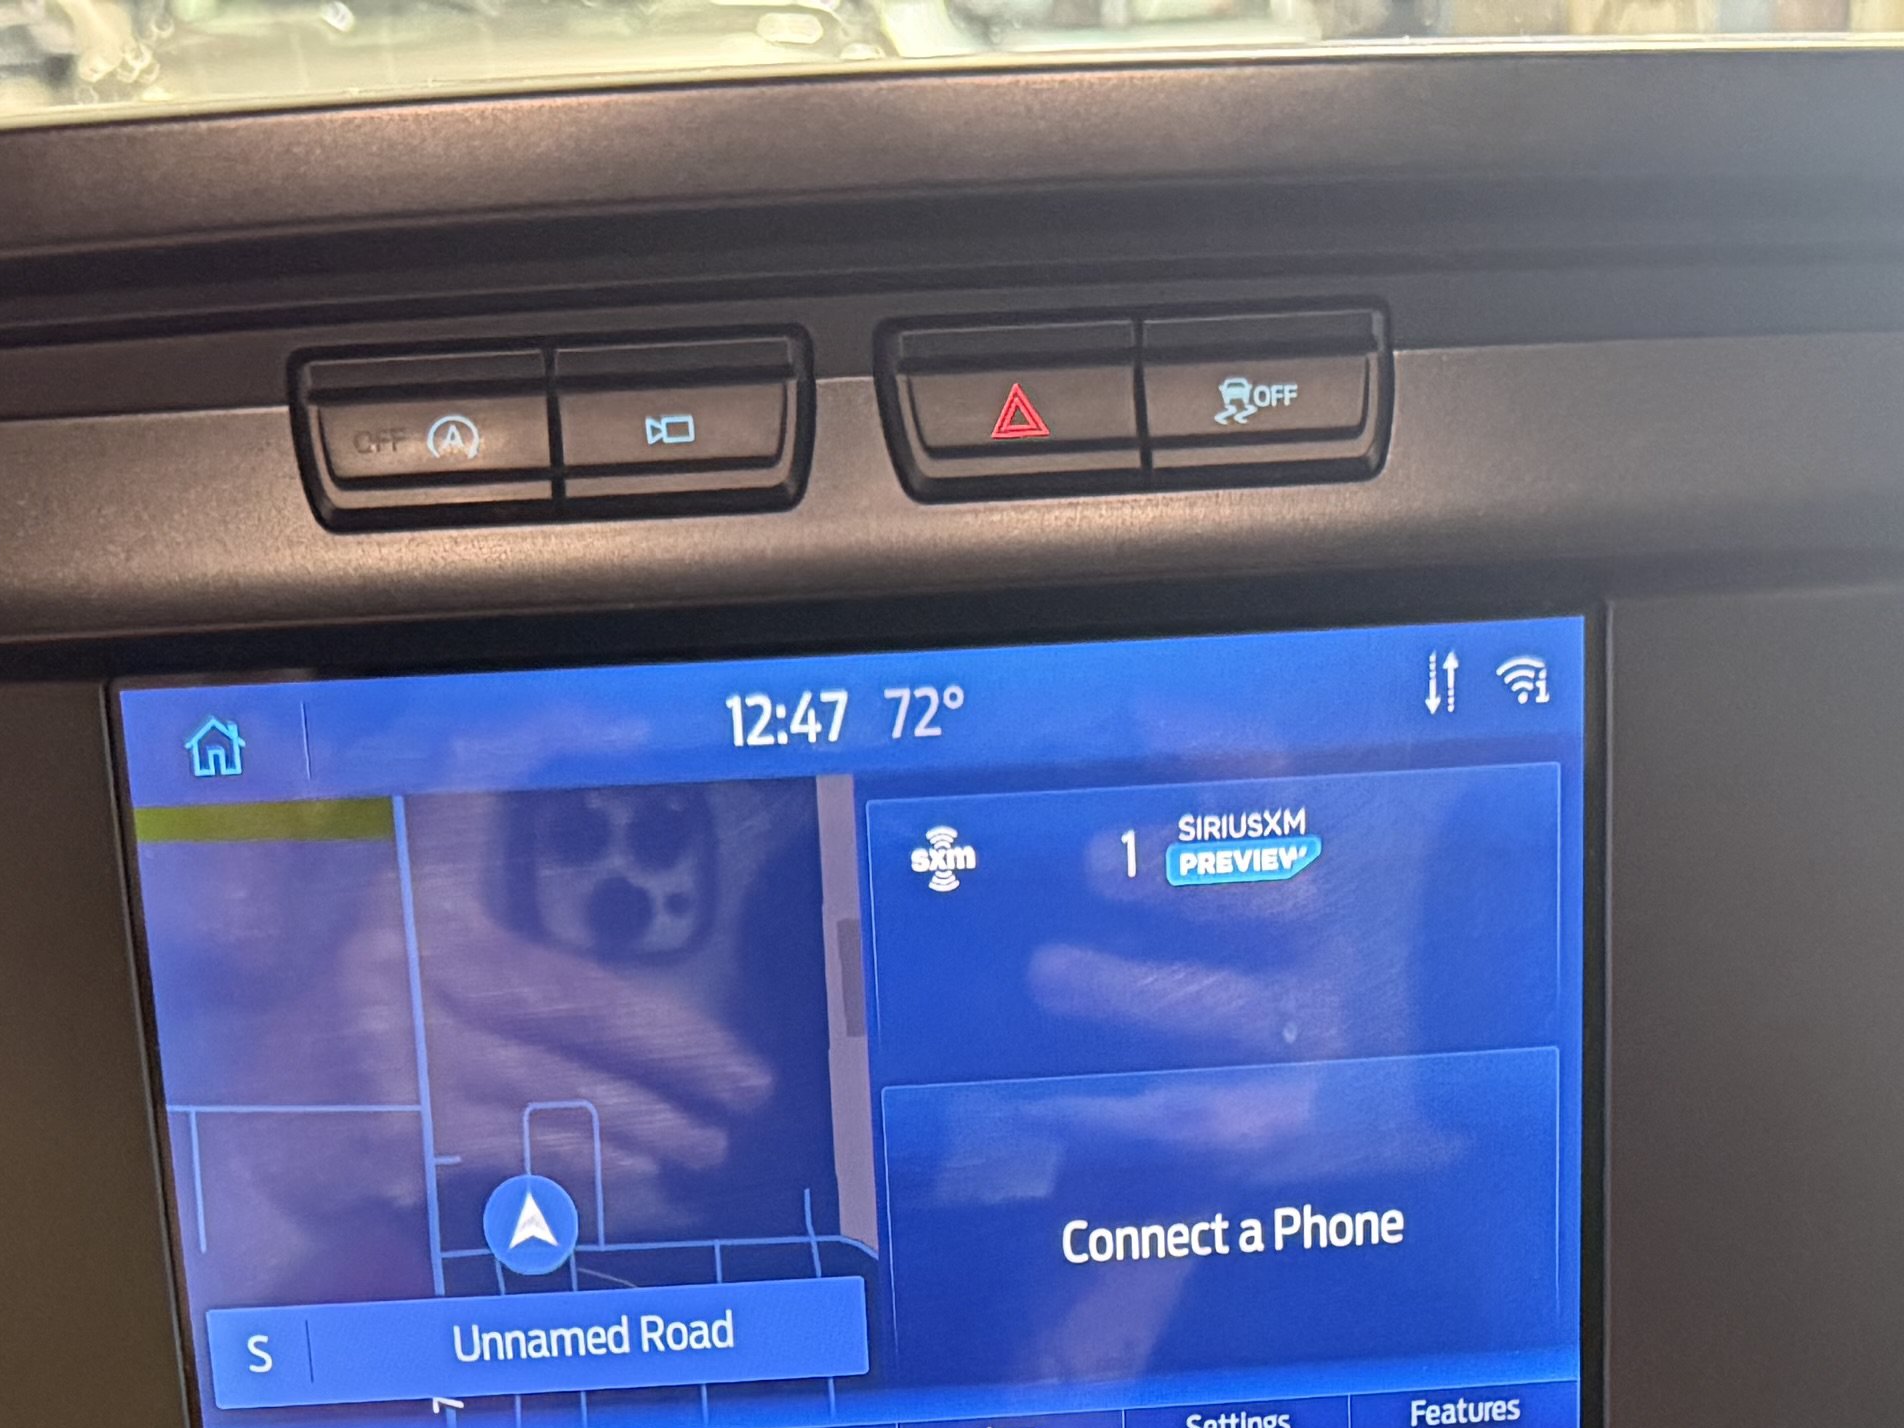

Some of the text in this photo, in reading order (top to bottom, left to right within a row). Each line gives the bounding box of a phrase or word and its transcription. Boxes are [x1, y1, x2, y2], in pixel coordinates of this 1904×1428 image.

[1253, 382, 1298, 407] OFF
[726, 685, 965, 748] 12:47 72°
[1120, 808, 1307, 879] 1 SIRIUSXM
[1178, 848, 1307, 876] PREVIEW
[1062, 1204, 1405, 1265] Connect a Phone
[247, 1334, 273, 1374] S
[453, 1309, 735, 1364] Unnamed Road
[1410, 1396, 1521, 1428] Features
